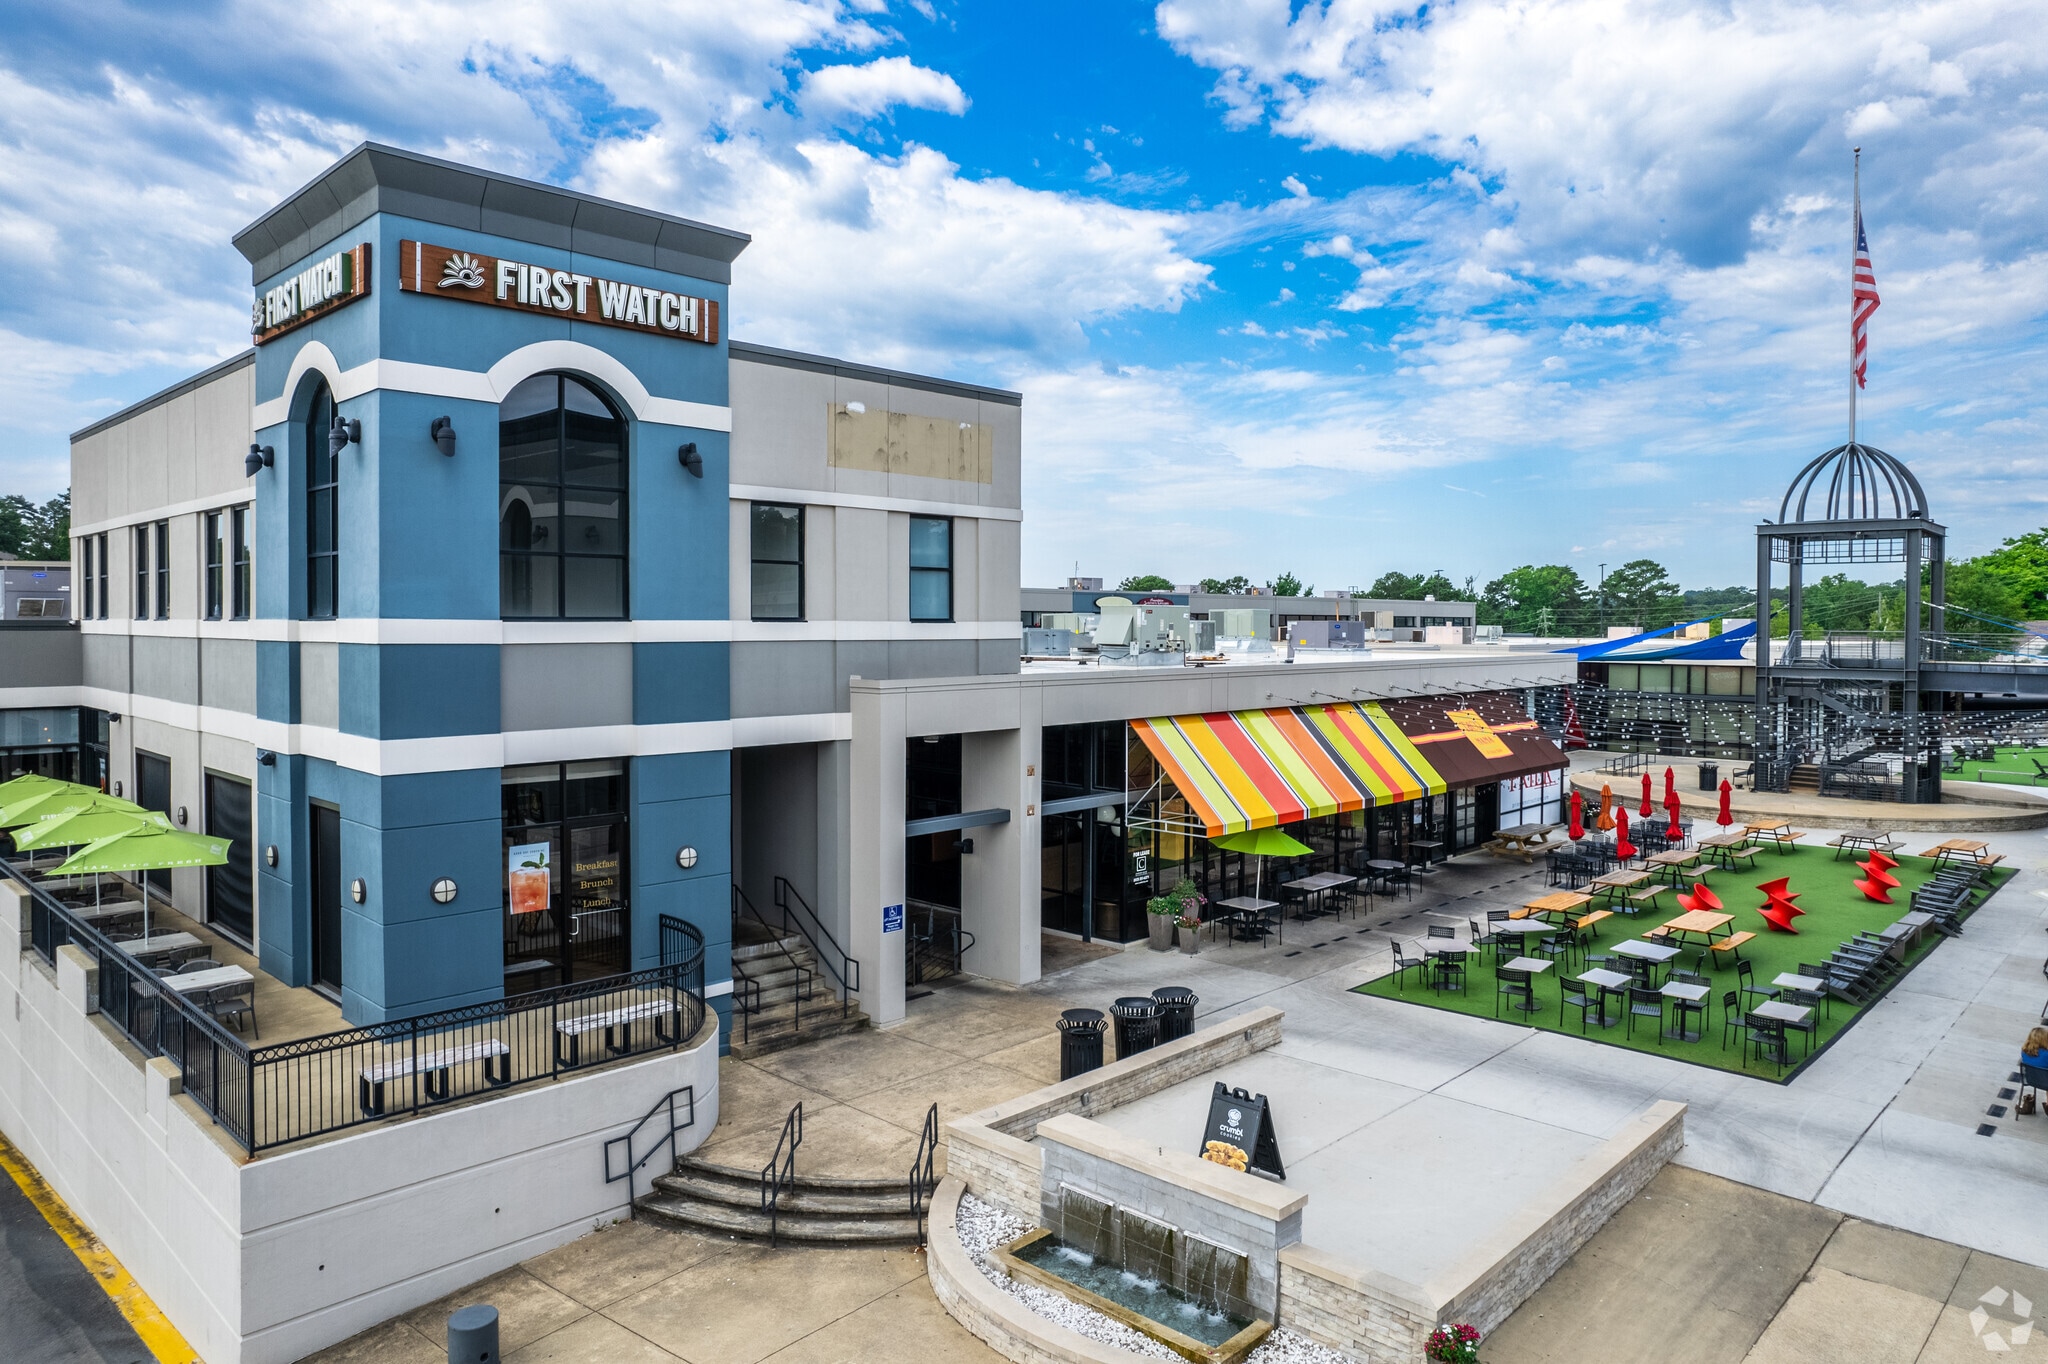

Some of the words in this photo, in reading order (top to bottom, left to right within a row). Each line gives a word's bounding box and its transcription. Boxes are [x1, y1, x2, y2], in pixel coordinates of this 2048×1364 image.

[265, 276, 298, 328] FIRST
[299, 252, 343, 311] WATCH
[496, 259, 592, 314] FIRST
[597, 279, 699, 334] WATCH
[576, 860, 618, 871] Breakfast
[580, 877, 614, 889] Brunch
[583, 897, 611, 908] Lunch
[1219, 1124, 1244, 1137] crumbl
[1220, 1131, 1241, 1141] cookies
